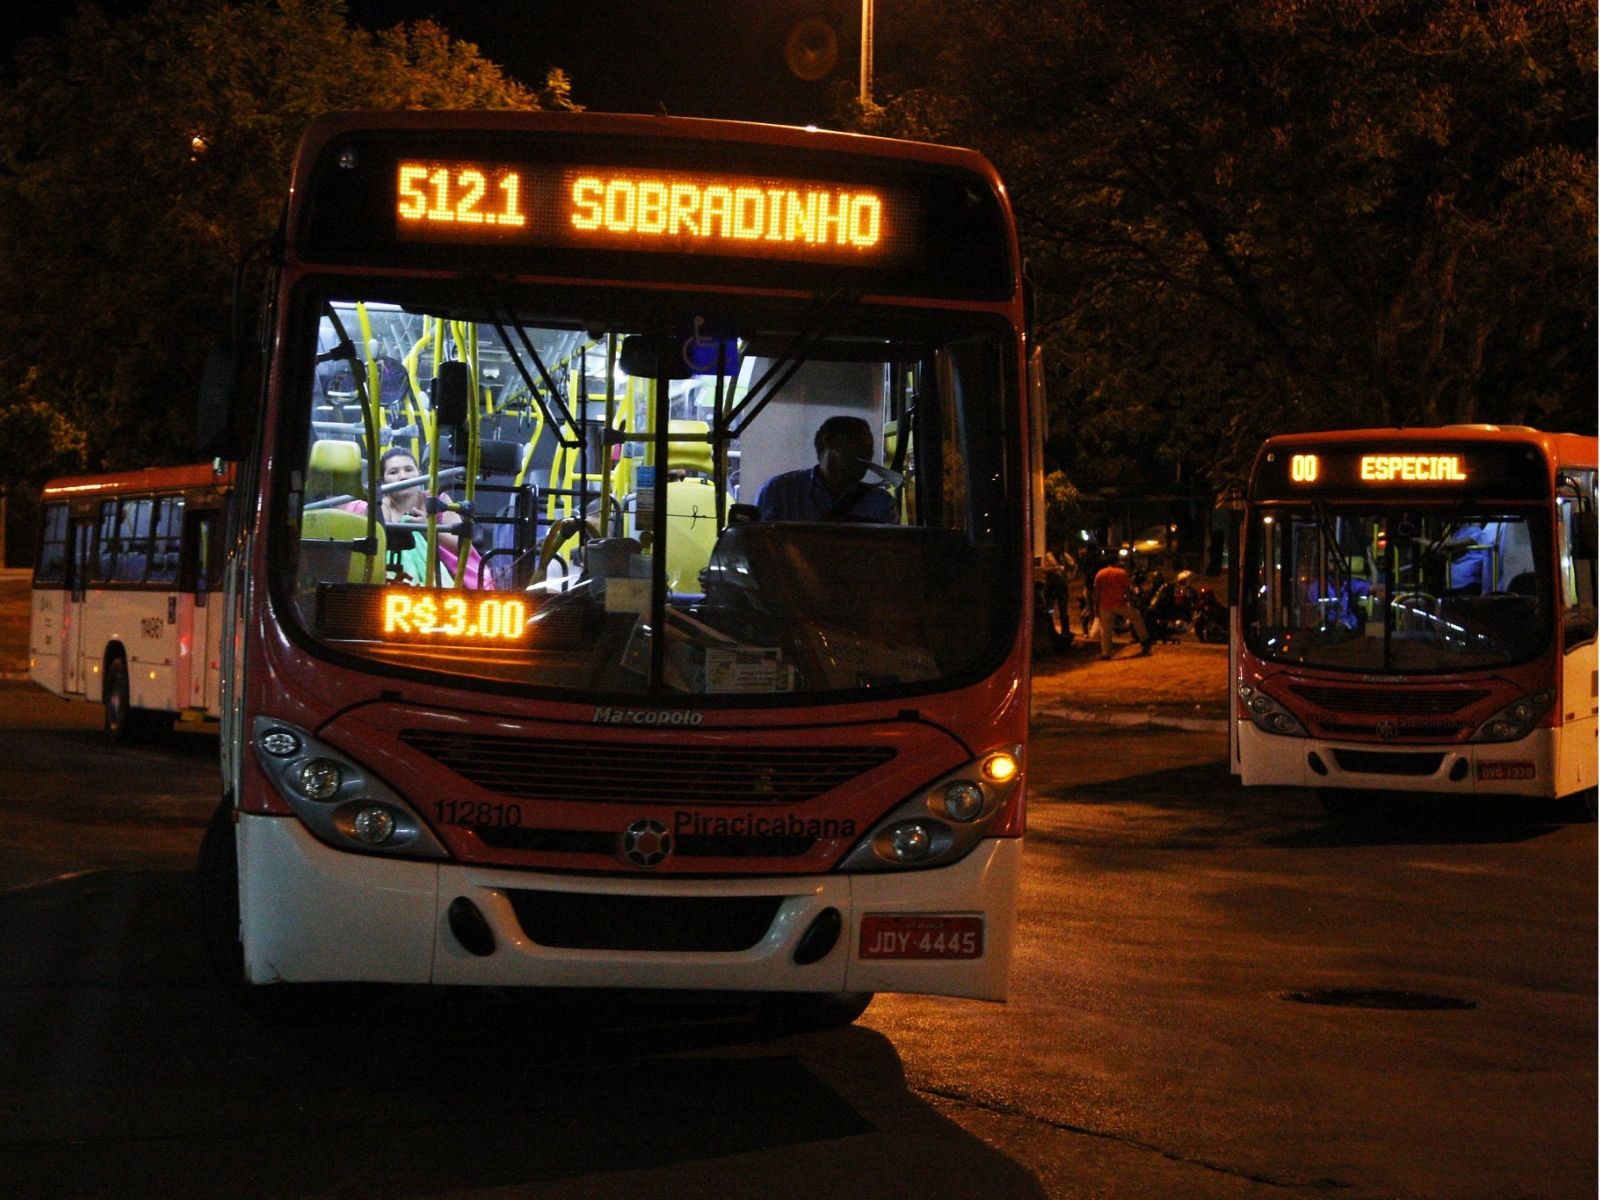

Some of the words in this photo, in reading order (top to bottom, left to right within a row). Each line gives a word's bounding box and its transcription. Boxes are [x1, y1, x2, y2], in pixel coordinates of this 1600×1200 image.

[398, 166, 525, 226] 512.1
[572, 177, 881, 246] SOBRADINHO
[1292, 455, 1318, 482] 00
[1361, 456, 1466, 480] ESPECIAL
[593, 707, 703, 726] Marcopolo
[434, 799, 522, 828] 112810
[674, 812, 855, 837] Piracicabana
[868, 931, 976, 953] JDY-4445
